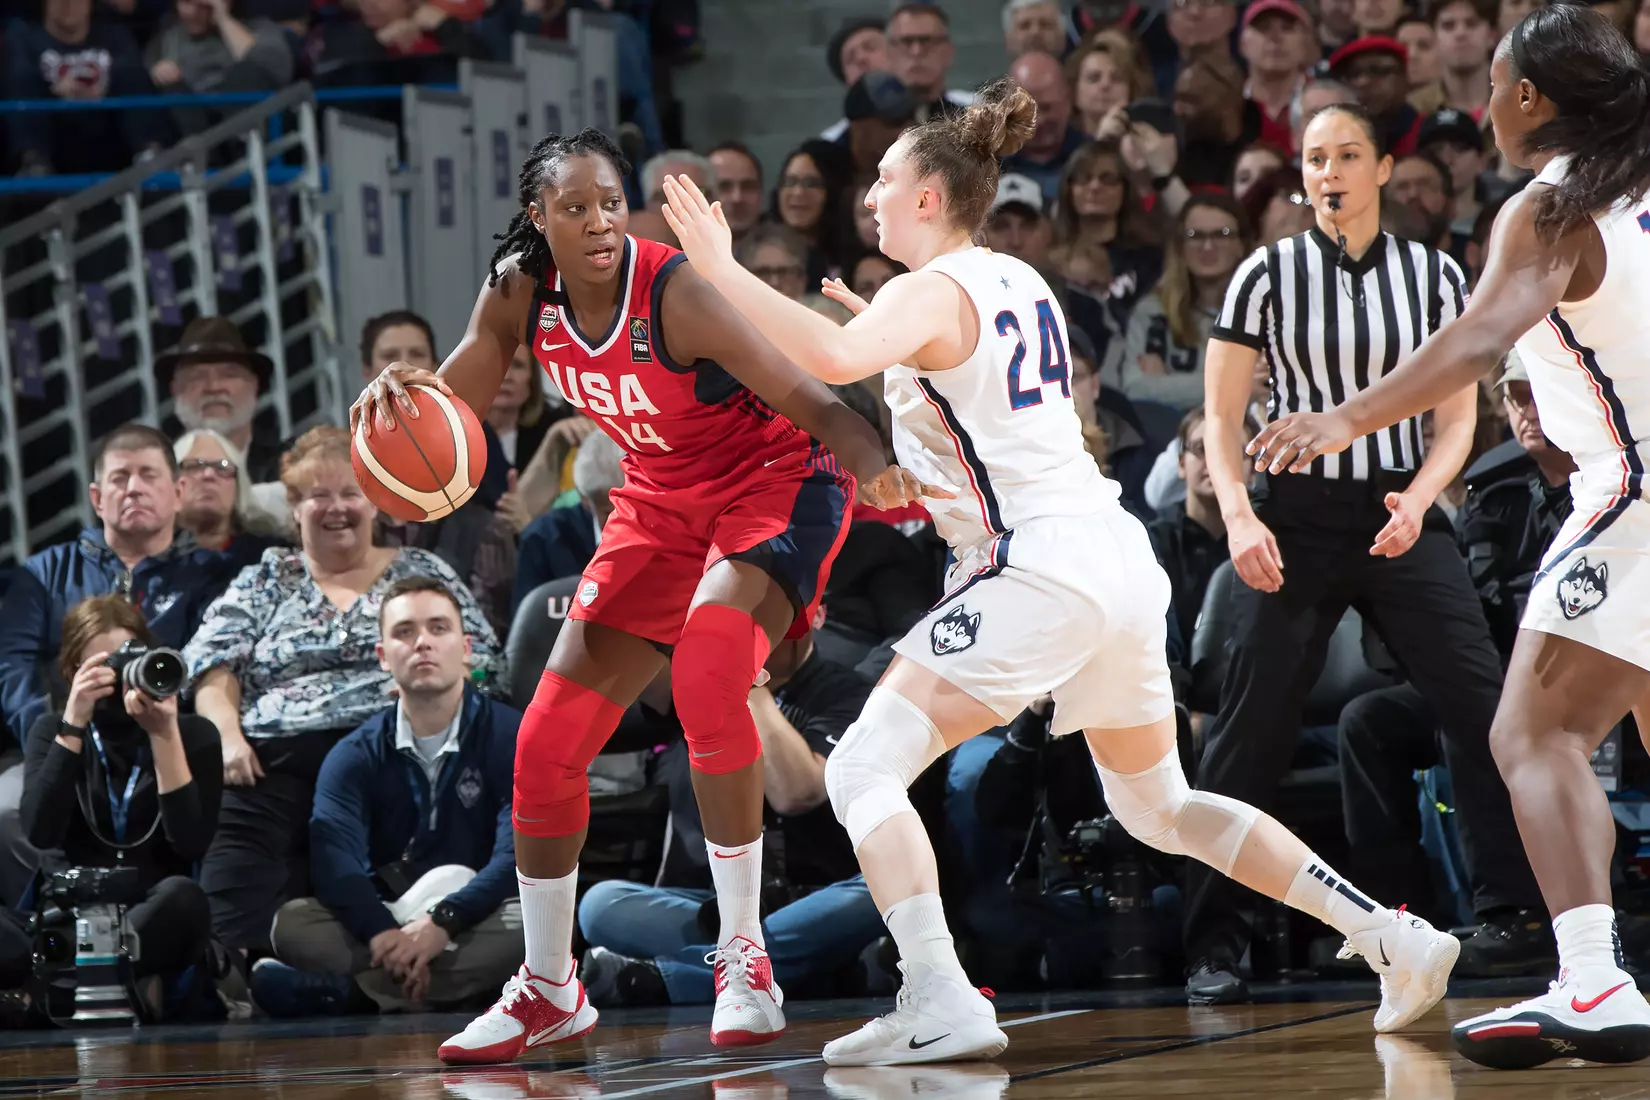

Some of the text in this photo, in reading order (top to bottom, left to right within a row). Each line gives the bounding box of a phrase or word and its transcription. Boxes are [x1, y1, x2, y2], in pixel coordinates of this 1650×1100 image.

[633, 343, 648, 352] FIBA
[994, 299, 1071, 411] 24
[549, 361, 661, 416] USA
[602, 416, 674, 452] 14
